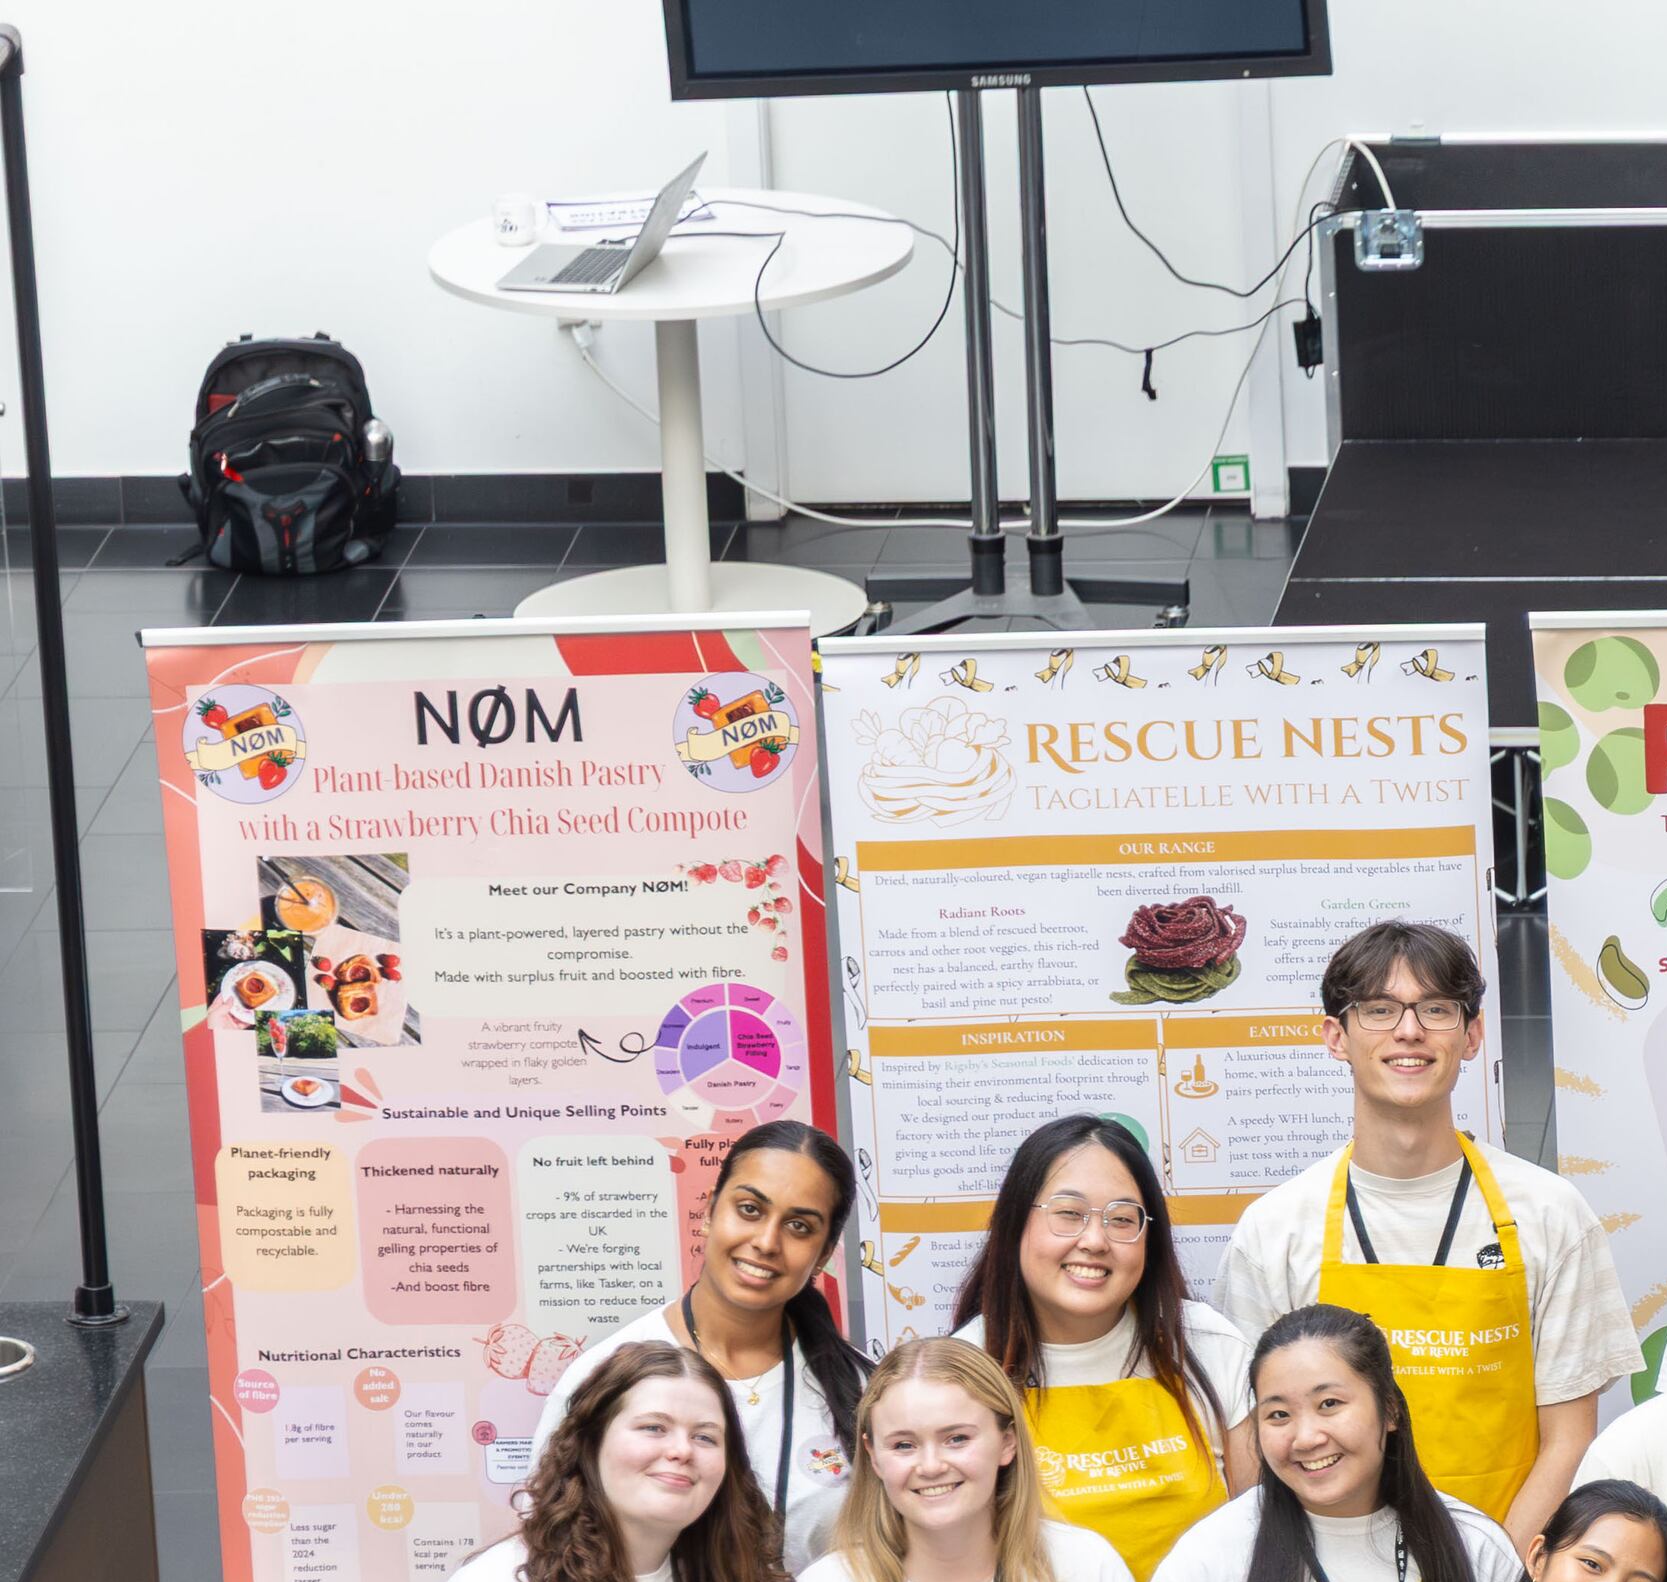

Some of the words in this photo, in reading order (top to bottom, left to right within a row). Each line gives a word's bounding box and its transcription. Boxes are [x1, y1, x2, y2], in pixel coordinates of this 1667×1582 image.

[971, 74, 1031, 87] SAMSUNG
[1025, 718, 1262, 775] RESCUE
[1283, 713, 1469, 761] NESTS
[313, 762, 473, 795] Plant-based
[479, 761, 572, 790] Danish
[581, 759, 666, 789] Pastry
[1337, 784, 1358, 804] A
[239, 814, 297, 841] with
[307, 821, 321, 840] a
[329, 811, 483, 843] Strawberry
[490, 810, 551, 837] Chia
[558, 807, 619, 836] Seed
[627, 805, 748, 836] Compote
[1119, 841, 1153, 855] OUR
[1159, 840, 1215, 854] RANGE
[489, 883, 526, 896] Meet
[531, 885, 558, 896] our
[562, 882, 636, 900] Company
[938, 905, 985, 920] Radiant
[990, 904, 1026, 918] Roots
[1320, 898, 1364, 911] Garden
[1368, 898, 1411, 910] Greens
[961, 1029, 1065, 1045] INSPIRATION
[1249, 1023, 1307, 1038] EATING
[382, 1105, 472, 1120] Sustainable
[477, 1105, 500, 1118] and
[505, 1105, 560, 1120] Unique
[565, 1104, 614, 1120] Selling
[619, 1103, 667, 1118] Points
[1390, 1327, 1464, 1351] RESCUE
[1470, 1323, 1520, 1344] NESTS
[258, 1348, 342, 1362] Nutritional
[347, 1345, 461, 1360] Characteristics
[1412, 1346, 1425, 1357] BY
[1429, 1345, 1470, 1358] REVIVE
